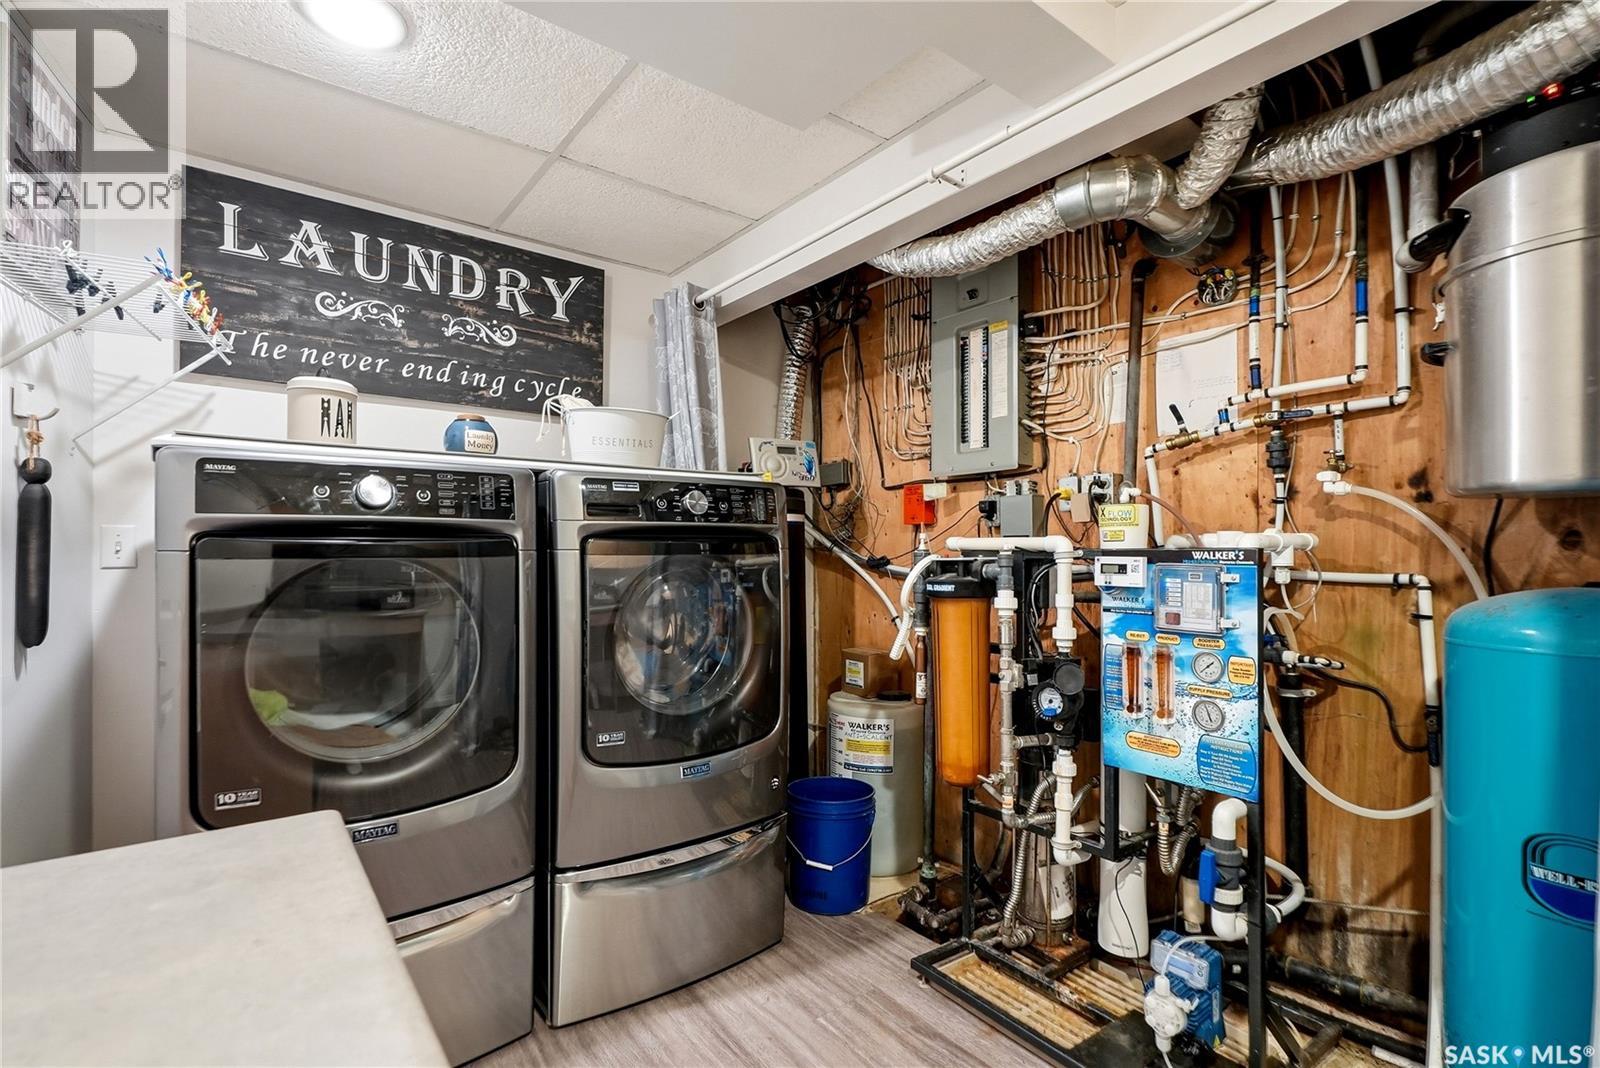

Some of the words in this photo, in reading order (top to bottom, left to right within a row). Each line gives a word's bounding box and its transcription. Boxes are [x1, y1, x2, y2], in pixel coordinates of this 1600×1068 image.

[218, 201, 585, 323] LAUNDRY
[216, 329, 288, 361] The
[299, 347, 390, 373] never
[514, 377, 582, 401] cycle
[466, 431, 494, 443] Laundry
[591, 435, 654, 450] ESSENTIALS
[467, 440, 494, 452] Money
[204, 463, 237, 471] MAYTAG
[1107, 509, 1133, 518] FLOW
[1191, 550, 1245, 560] WALKER'S
[1205, 689, 1231, 697] PRESSURE
[847, 721, 890, 731] WALKER'S
[598, 734, 610, 743] 10
[683, 762, 711, 777] MAYTAG
[217, 792, 237, 805] 10
[353, 822, 397, 842] MAYTAG
